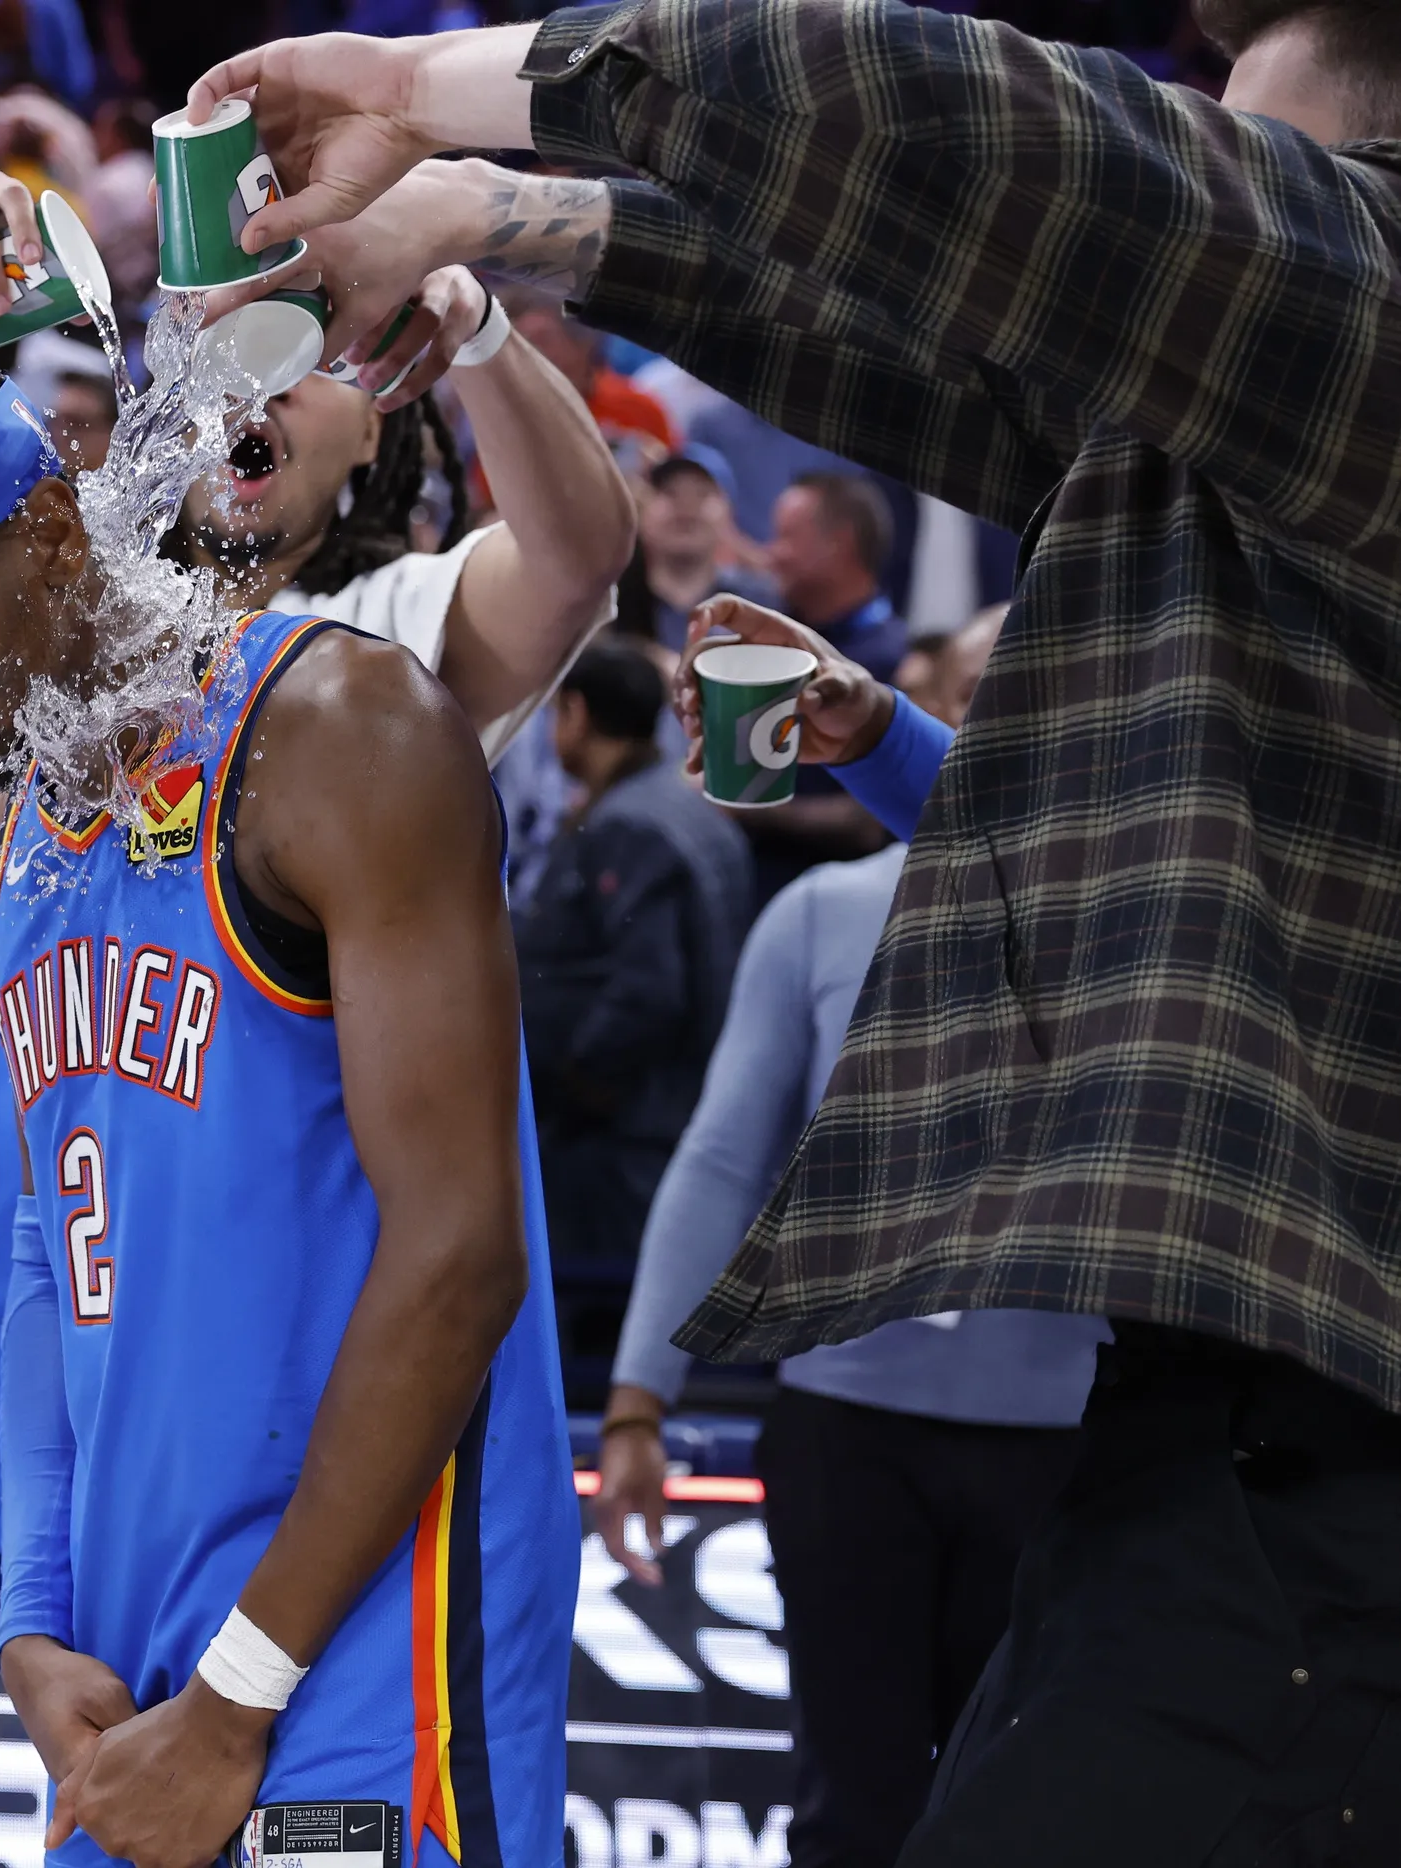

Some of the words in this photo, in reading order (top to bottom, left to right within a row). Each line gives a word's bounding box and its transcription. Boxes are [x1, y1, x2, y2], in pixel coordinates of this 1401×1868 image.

[57, 1126, 115, 1325] 2
[286, 1809, 340, 1818] ENGINEERED
[267, 1824, 279, 1837] 48
